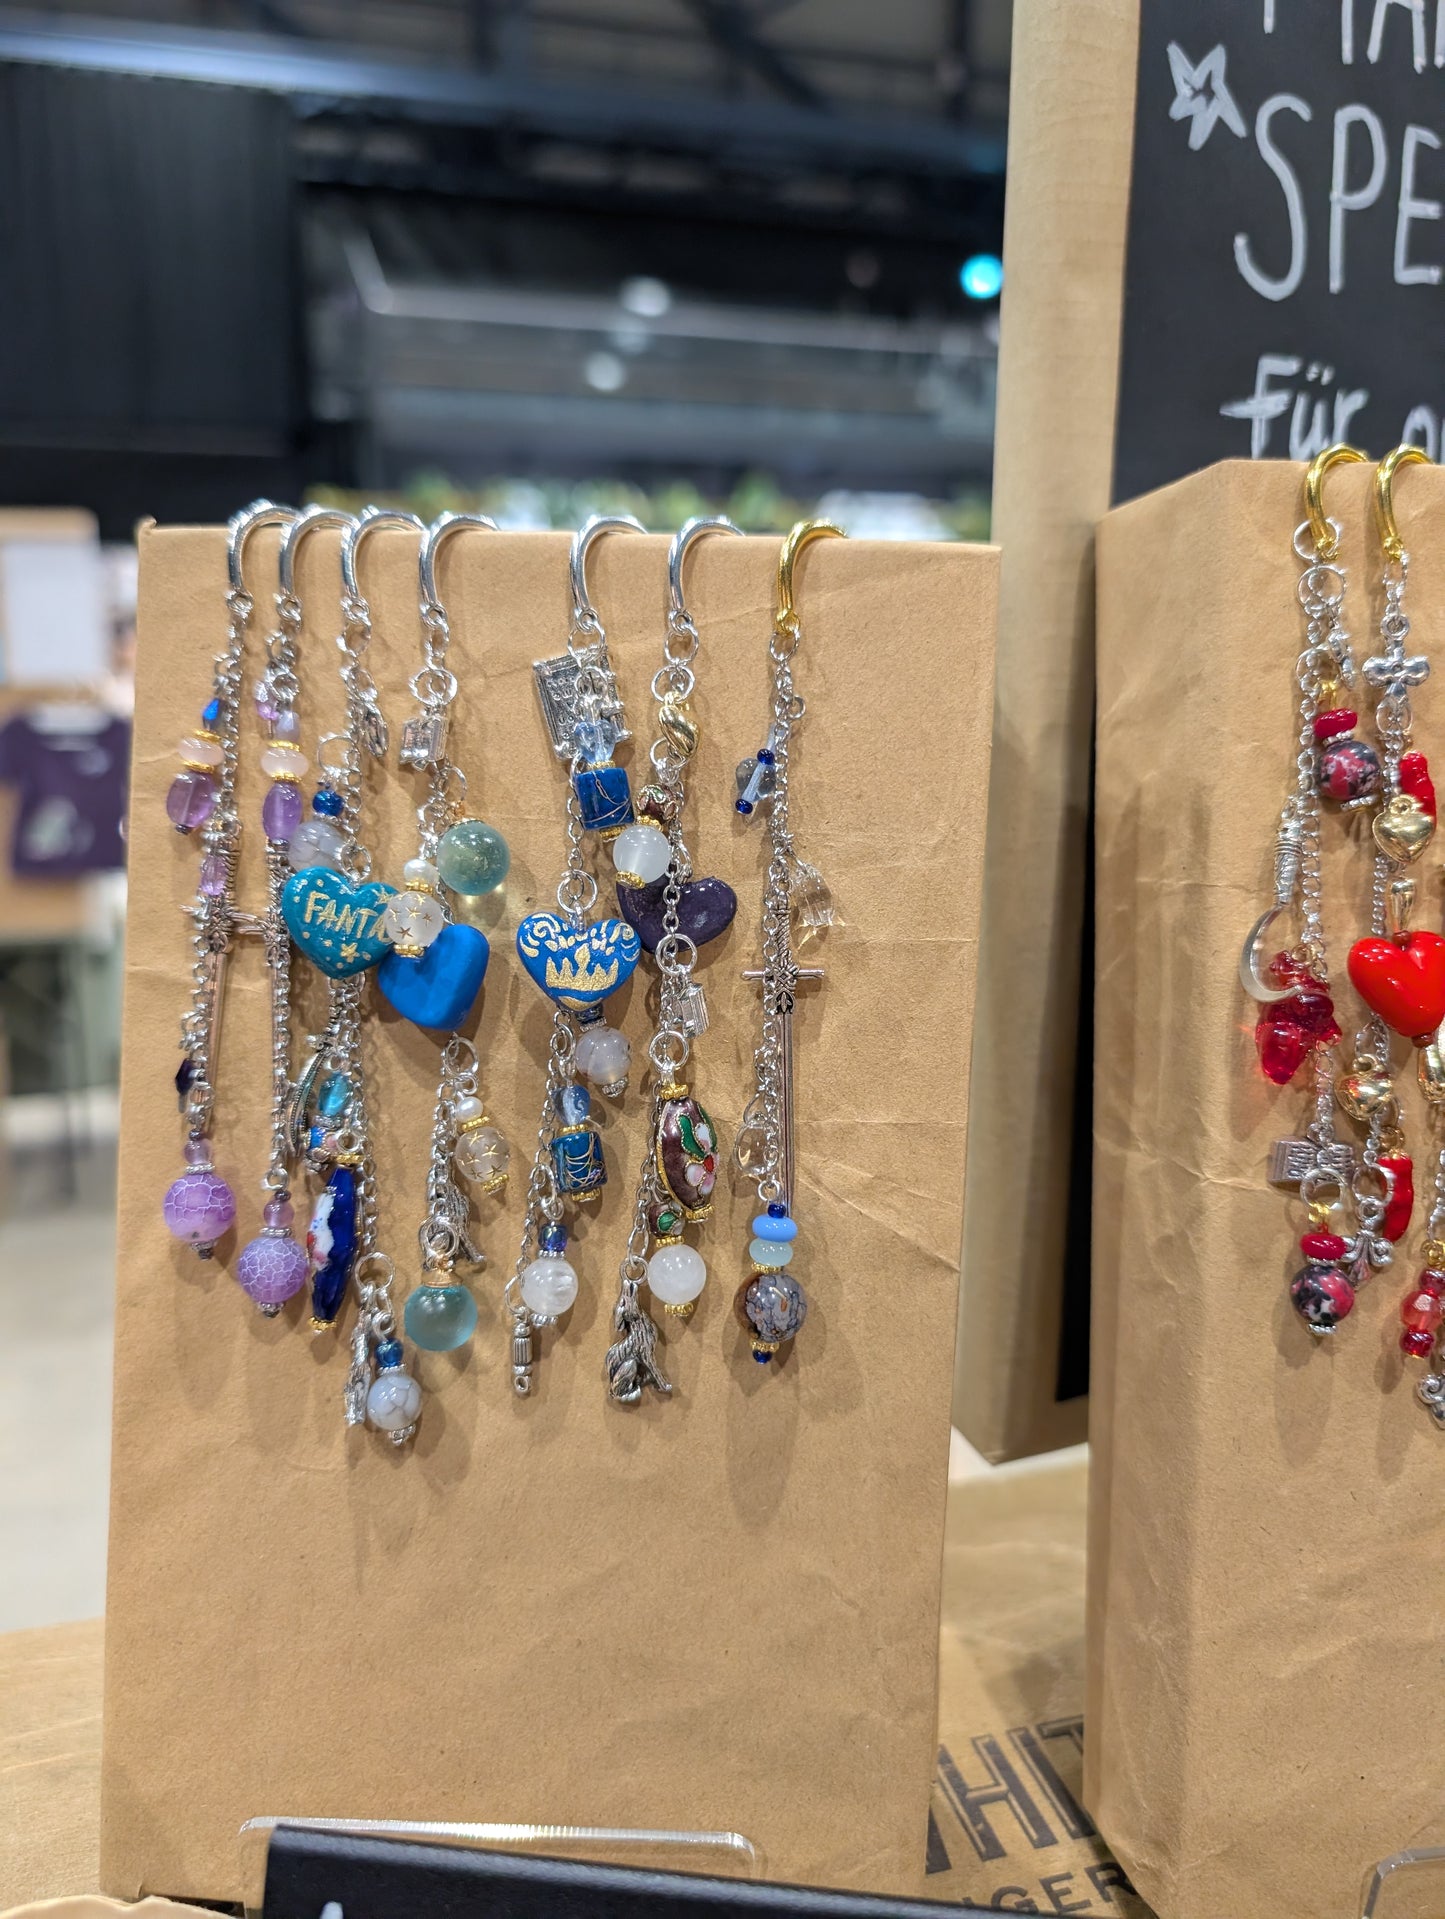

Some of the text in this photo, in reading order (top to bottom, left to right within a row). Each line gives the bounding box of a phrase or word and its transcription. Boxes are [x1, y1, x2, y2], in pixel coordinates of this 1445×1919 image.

[1234, 92, 1441, 301] SPE
[1219, 353, 1370, 460] Für
[304, 890, 395, 944] FANTA
[961, 1862, 1138, 1914] GER
